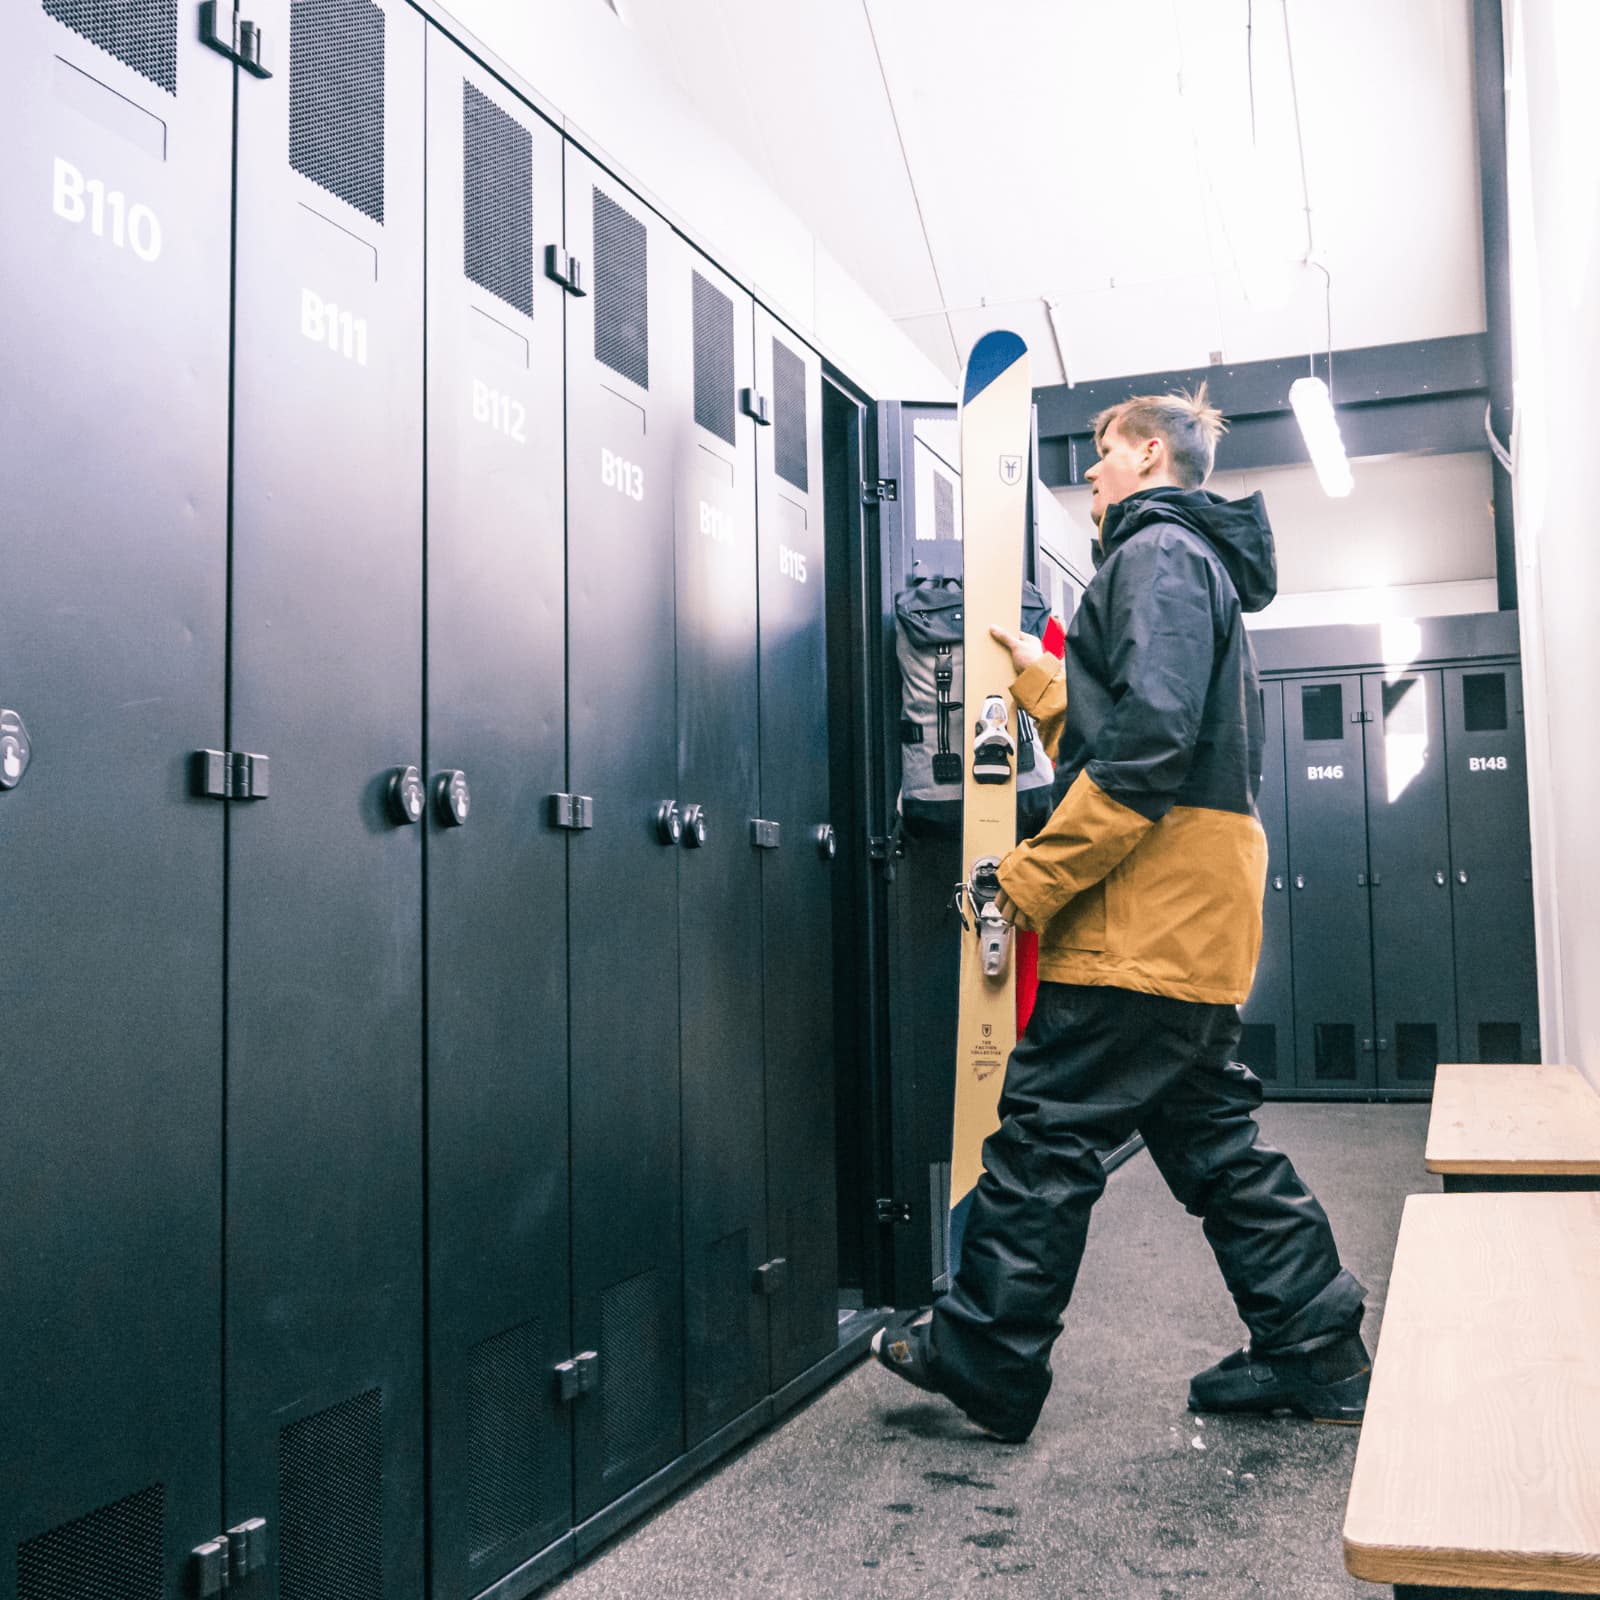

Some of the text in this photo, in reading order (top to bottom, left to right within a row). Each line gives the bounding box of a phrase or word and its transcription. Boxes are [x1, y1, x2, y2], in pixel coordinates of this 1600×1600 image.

[52, 156, 162, 263] B110
[300, 287, 368, 367] B111
[471, 379, 527, 444] B112
[600, 447, 645, 502] B113
[778, 544, 808, 584] B115
[1307, 765, 1344, 781] B146
[1468, 756, 1508, 772] B148
